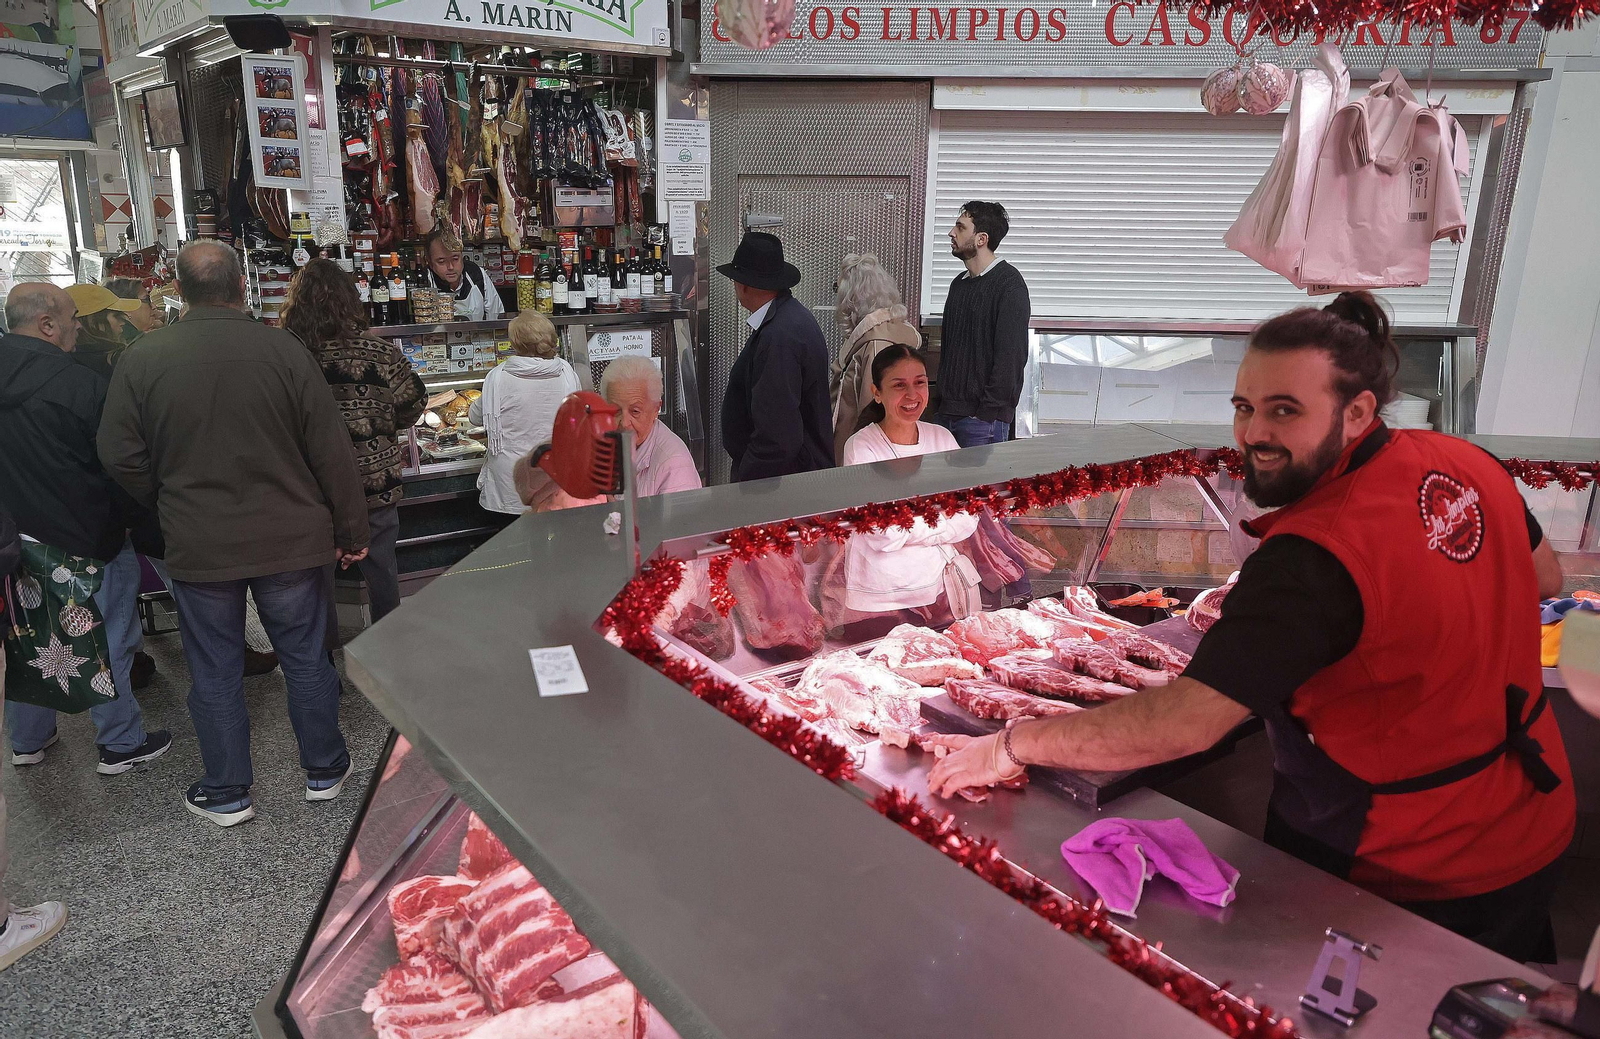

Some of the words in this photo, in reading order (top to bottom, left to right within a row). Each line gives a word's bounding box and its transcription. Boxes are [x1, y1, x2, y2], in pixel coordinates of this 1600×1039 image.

[443, 0, 471, 23] A.
[481, 0, 573, 33] MARÍN
[880, 7, 1067, 42] LIMPIOS
